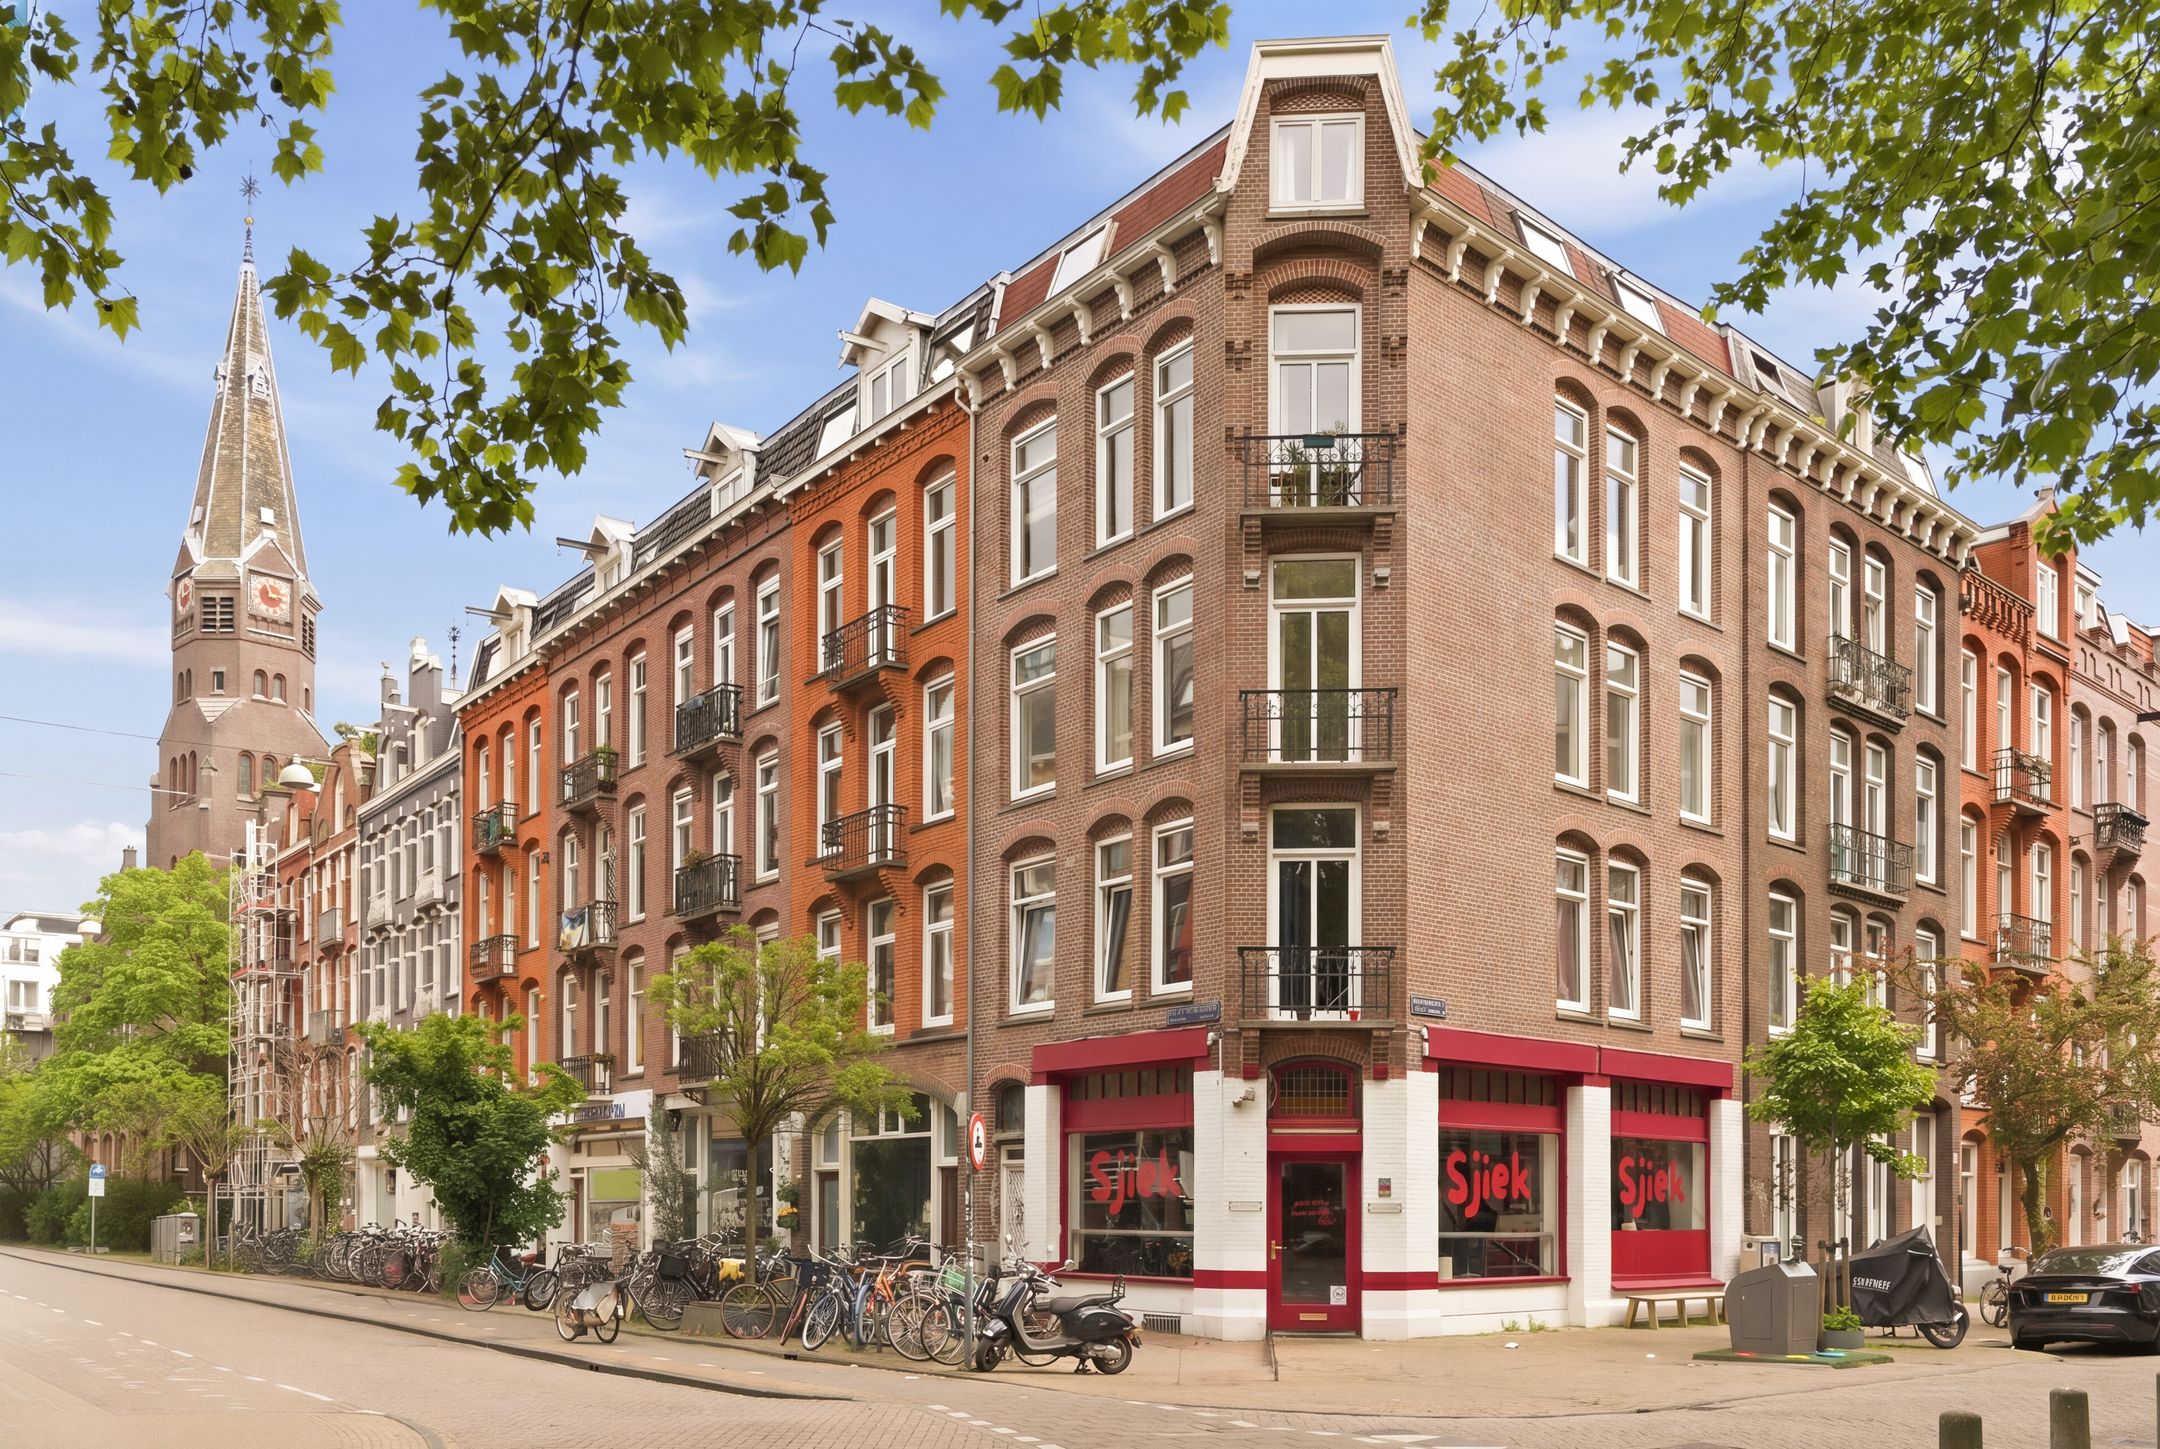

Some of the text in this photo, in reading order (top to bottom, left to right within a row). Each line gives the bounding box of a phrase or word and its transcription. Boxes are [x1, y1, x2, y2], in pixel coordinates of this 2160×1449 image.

[1090, 1147, 1183, 1216] Sjiek
[1446, 1149, 1531, 1218] Sjiek
[1618, 1156, 1685, 1218] Sjiek
